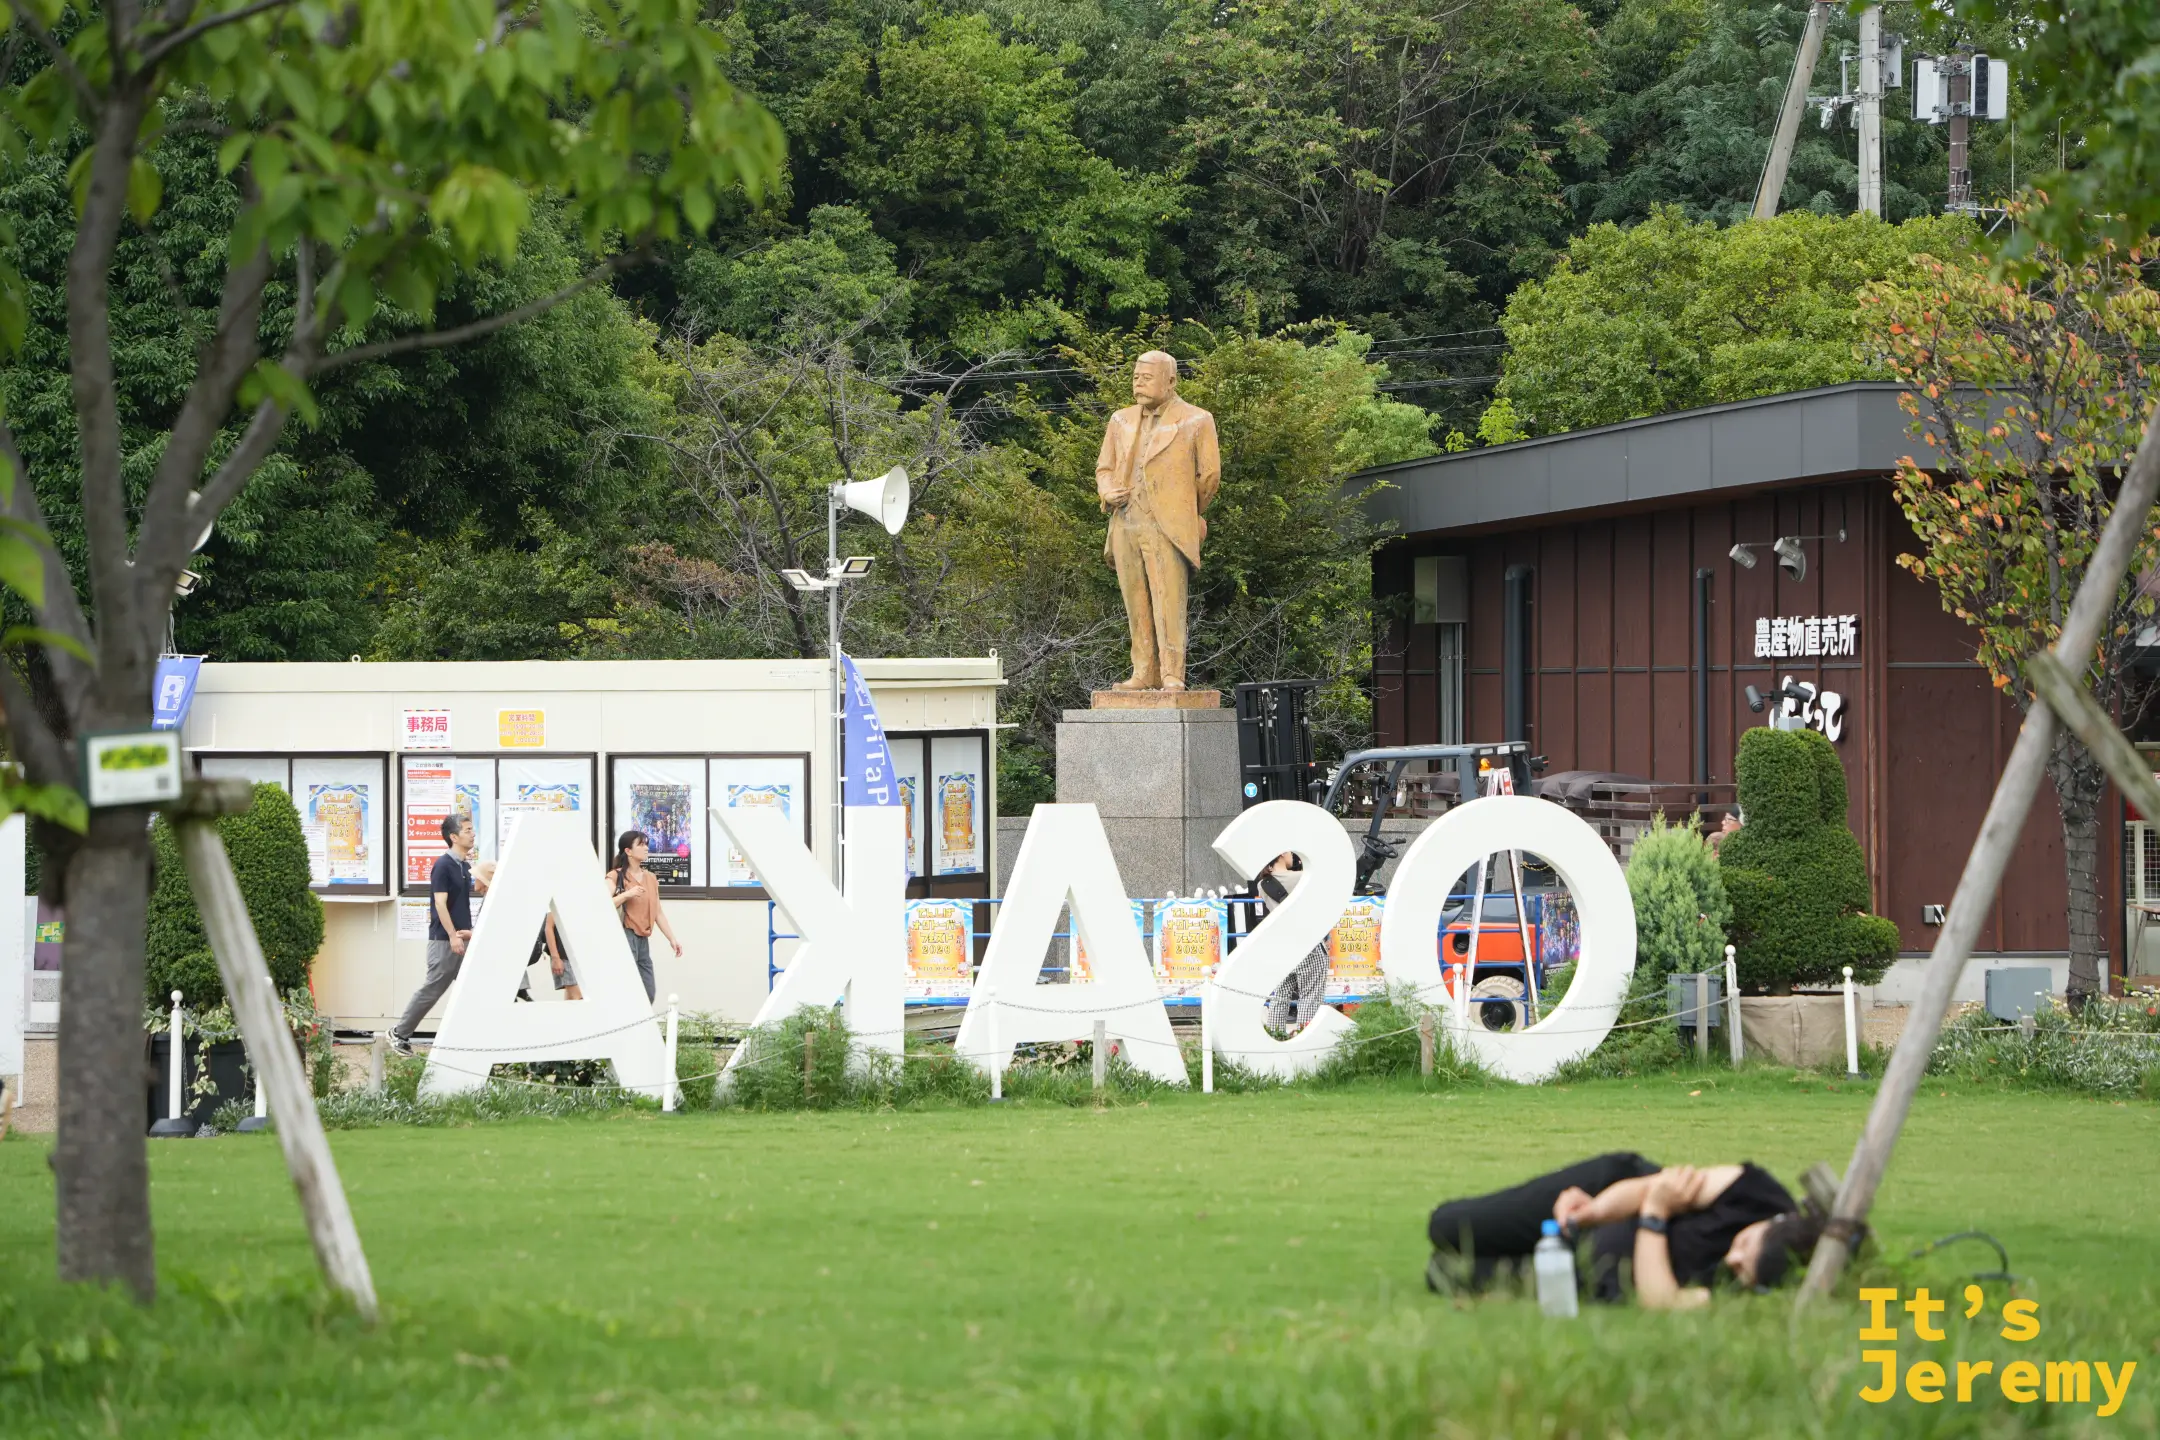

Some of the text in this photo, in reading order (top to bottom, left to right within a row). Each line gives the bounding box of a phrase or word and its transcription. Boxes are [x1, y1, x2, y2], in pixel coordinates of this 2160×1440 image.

[1754, 614, 1858, 658] 農産物直売所
[406, 716, 448, 733] 事務局
[917, 907, 956, 919] てんしば
[1171, 907, 1211, 919] てんしば
[912, 919, 962, 931] オクトーバー
[1166, 919, 1216, 931] オクトーバー
[919, 931, 955, 944] フェスト
[1173, 931, 1208, 944] フェスト
[1338, 929, 1372, 942] フェスト
